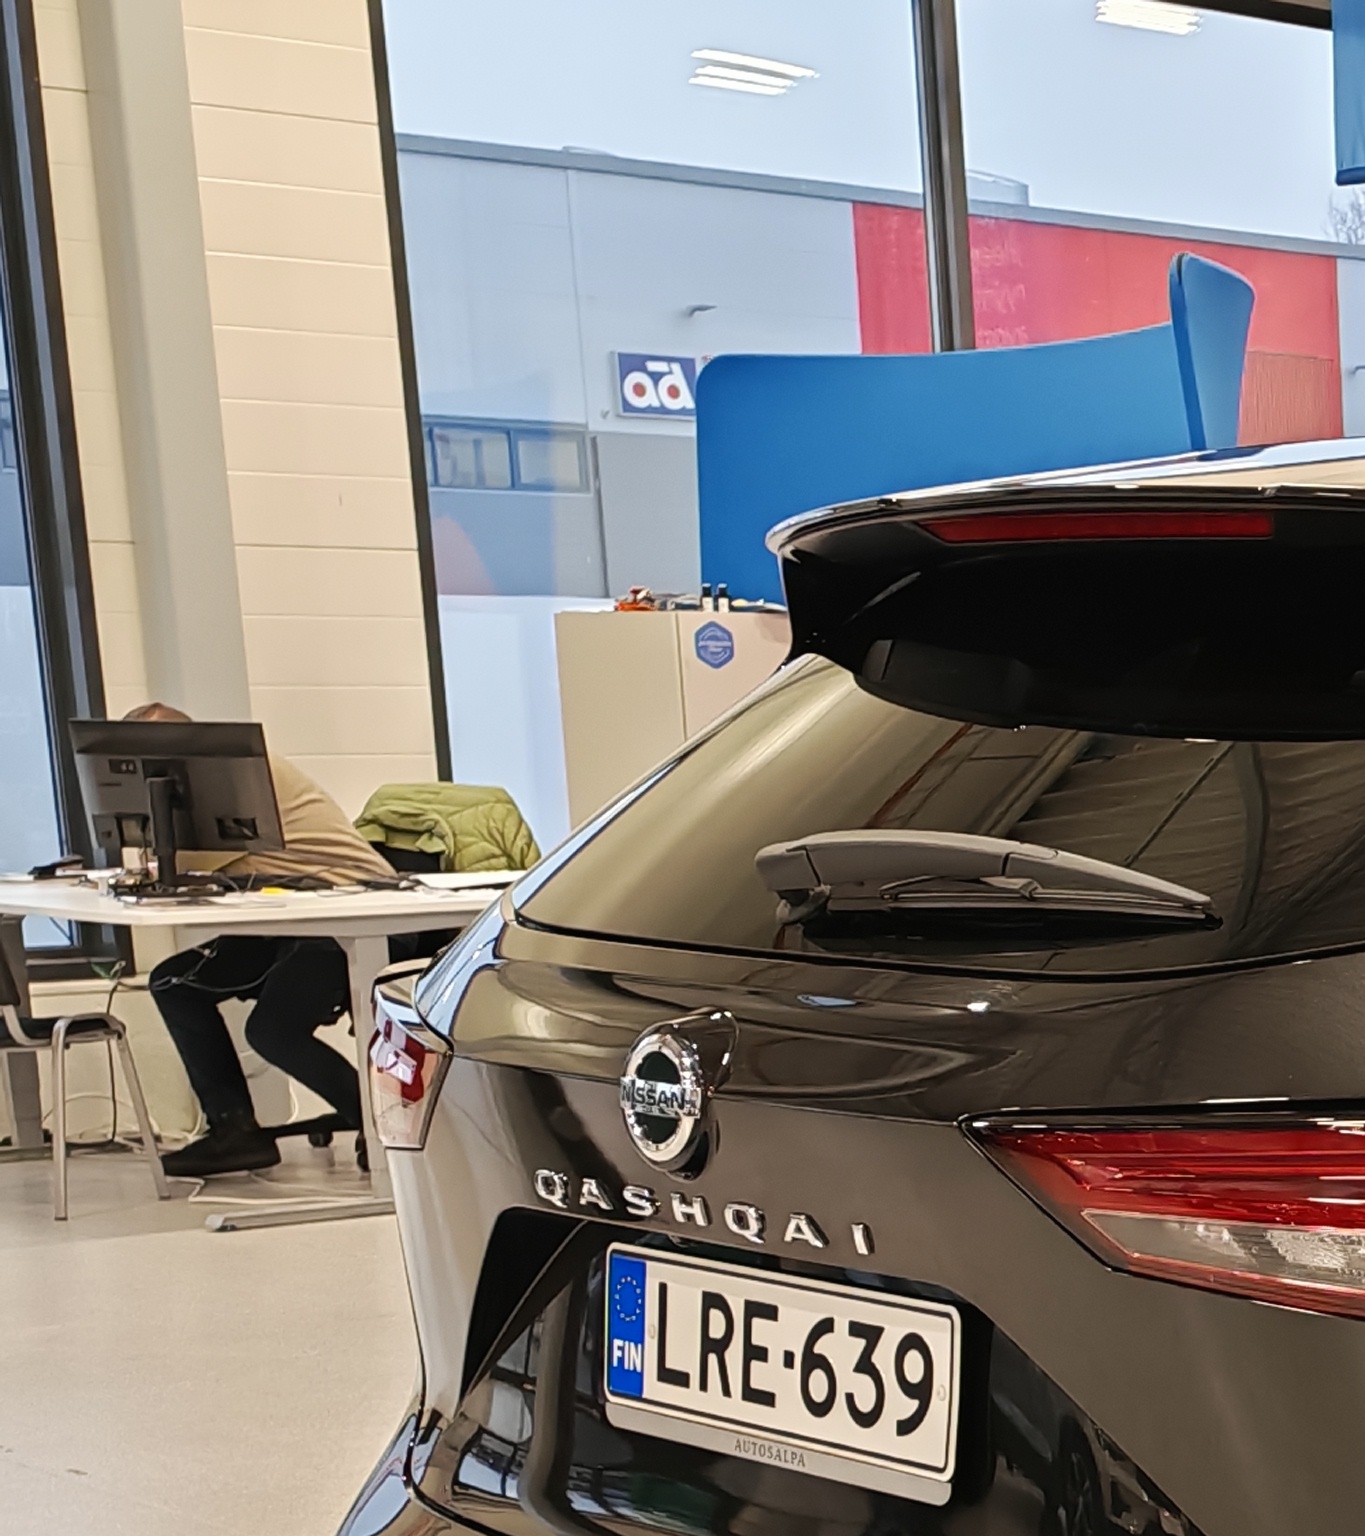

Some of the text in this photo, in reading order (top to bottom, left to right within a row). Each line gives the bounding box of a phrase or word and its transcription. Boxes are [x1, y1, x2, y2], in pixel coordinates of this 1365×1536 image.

[621, 1078, 686, 1111] NISSAN
[533, 1168, 875, 1256] QASHQAI
[611, 1337, 643, 1374] FIN
[656, 1280, 934, 1437] LRE-639
[733, 1436, 807, 1469] AUTOSALPA
